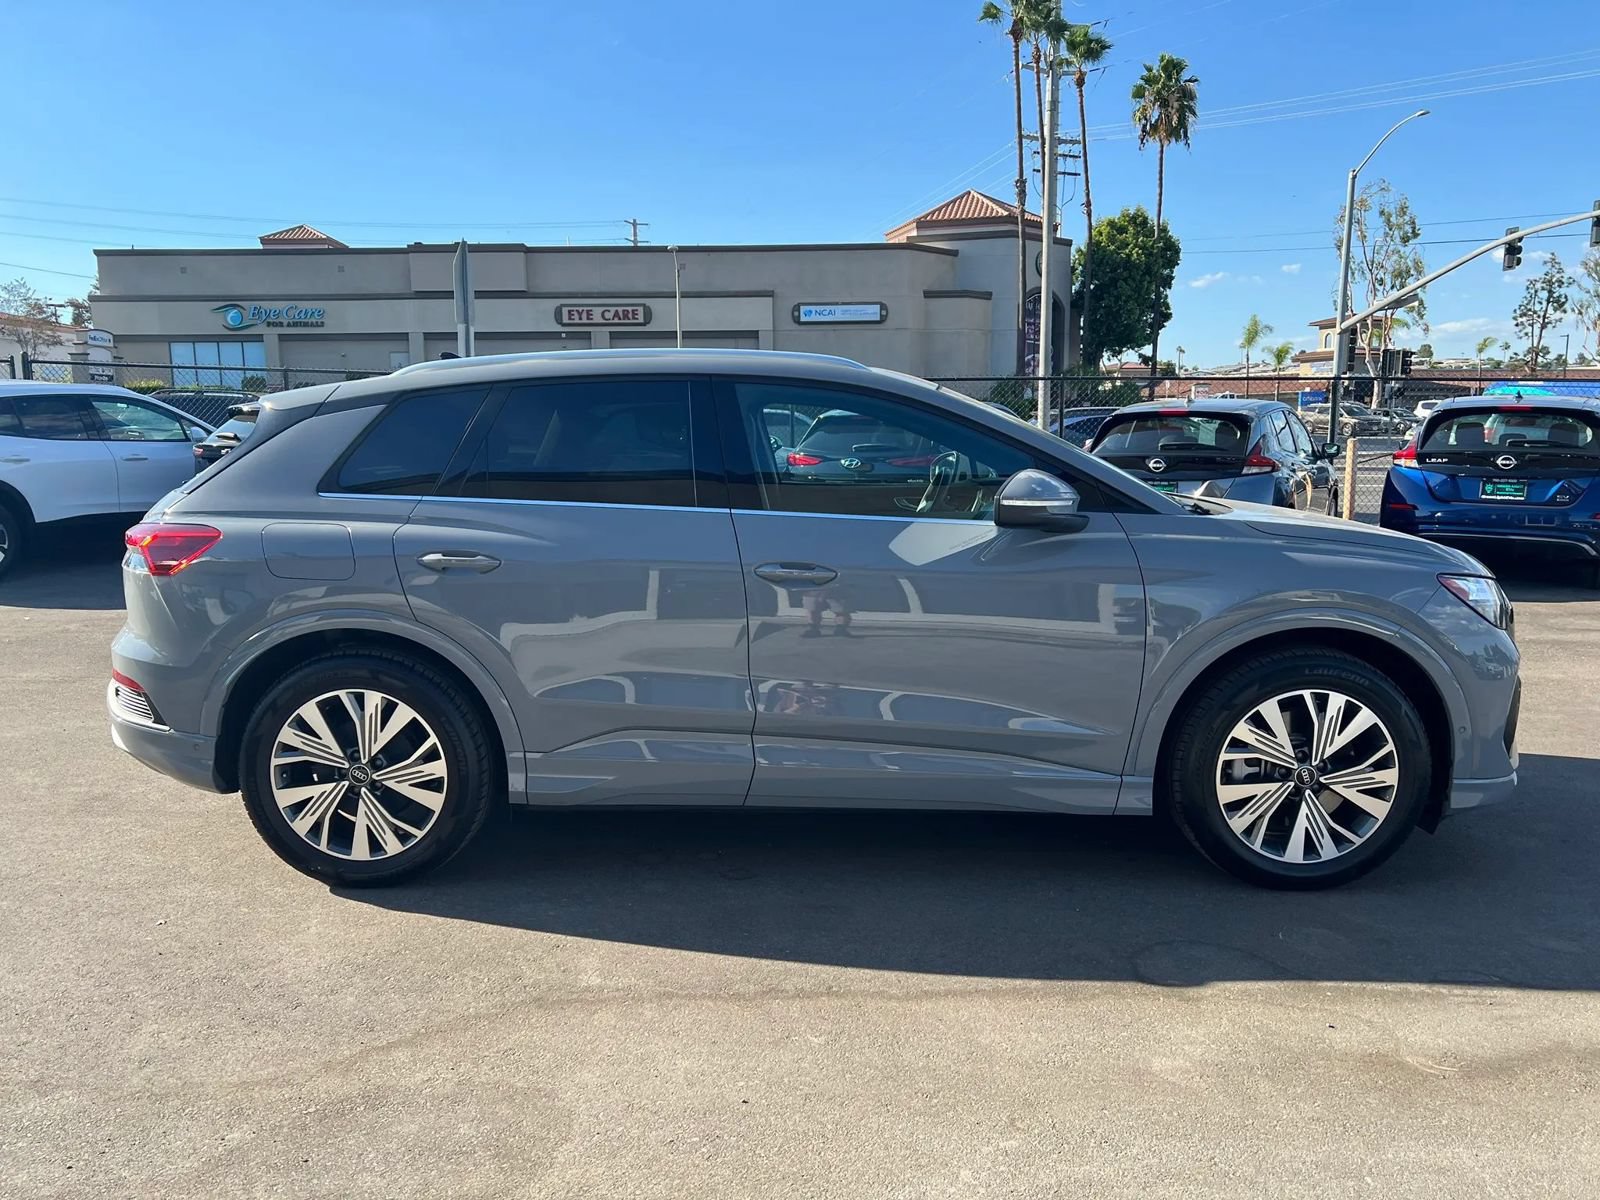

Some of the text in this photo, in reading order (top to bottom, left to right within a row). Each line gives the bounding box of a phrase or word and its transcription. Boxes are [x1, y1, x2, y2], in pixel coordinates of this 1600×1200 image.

[248, 304, 325, 326] Eye Care
[567, 309, 639, 321] EYE CARE
[814, 309, 836, 317] NCAI
